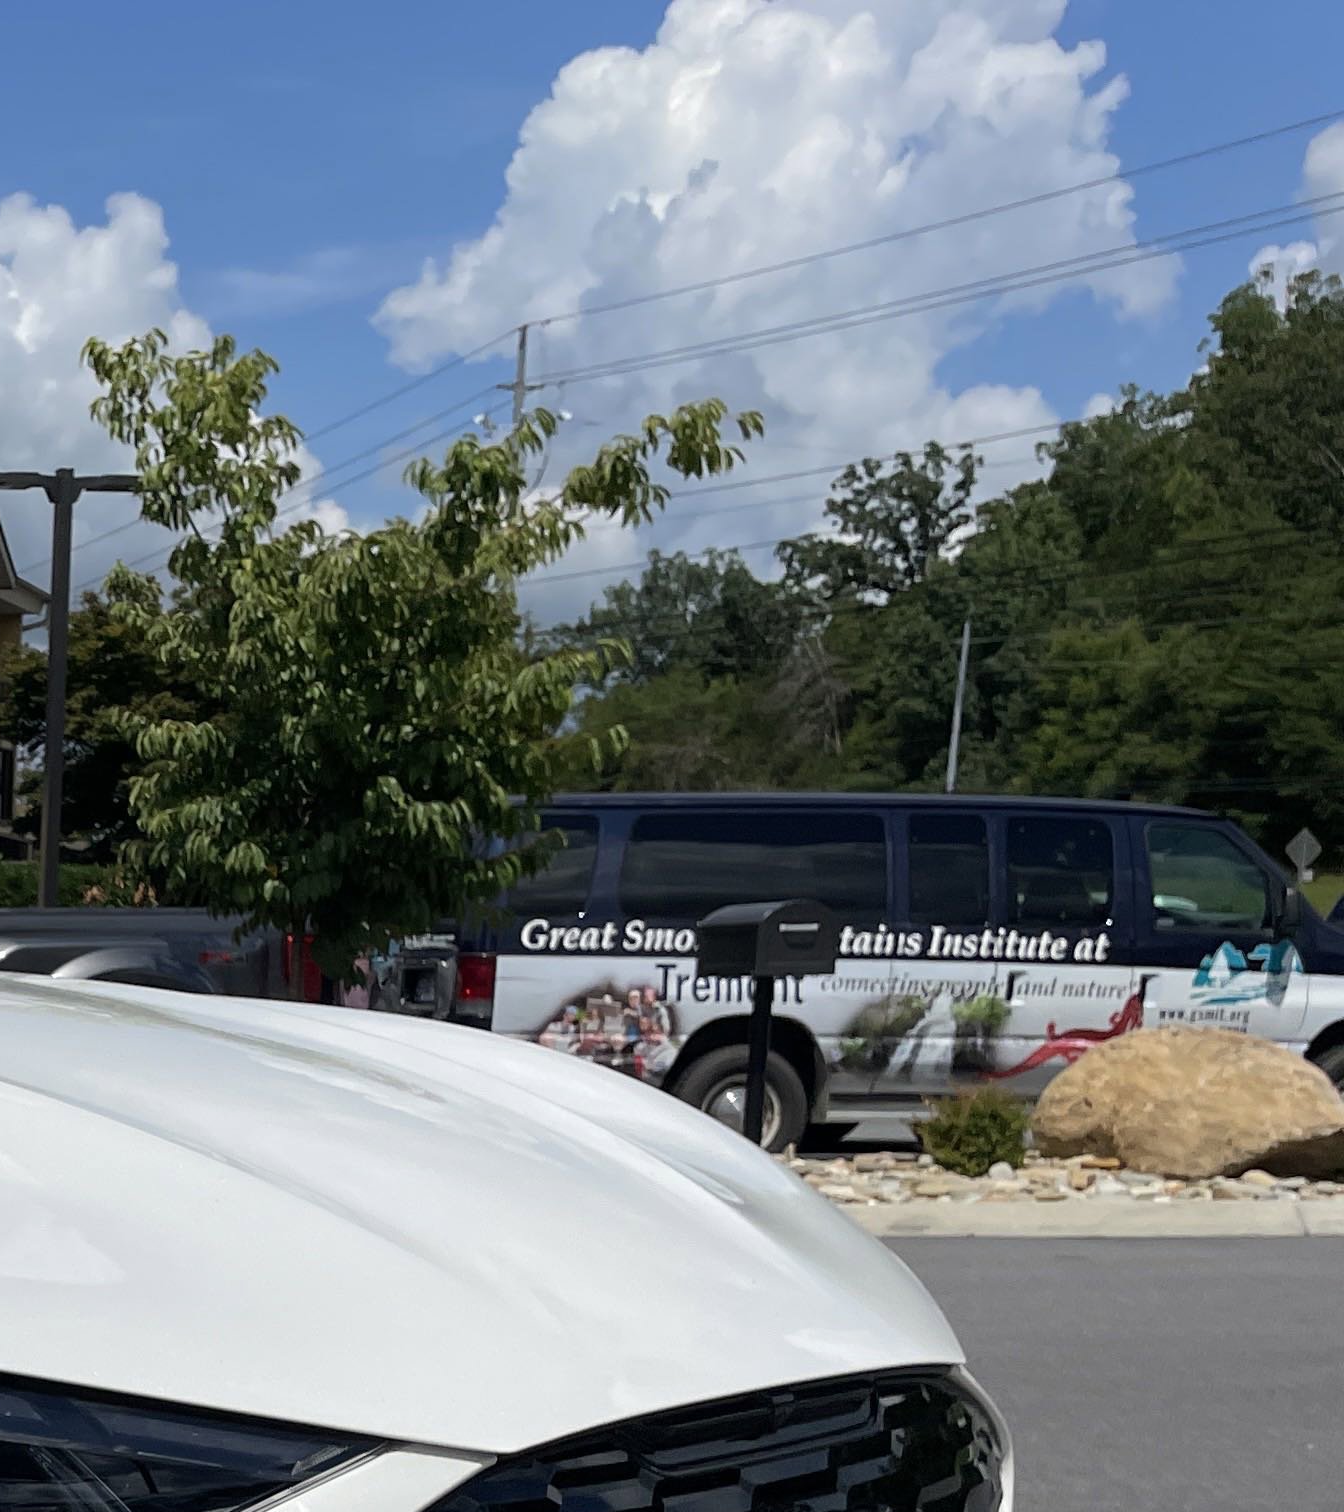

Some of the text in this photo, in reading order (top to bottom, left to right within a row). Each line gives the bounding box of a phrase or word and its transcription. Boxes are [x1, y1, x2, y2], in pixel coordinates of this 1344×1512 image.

[520, 918, 1111, 963] Great Smo tains Institute at
[820, 972, 931, 998] connecting
[932, 975, 1004, 1003] people
[1016, 976, 1057, 996] and
